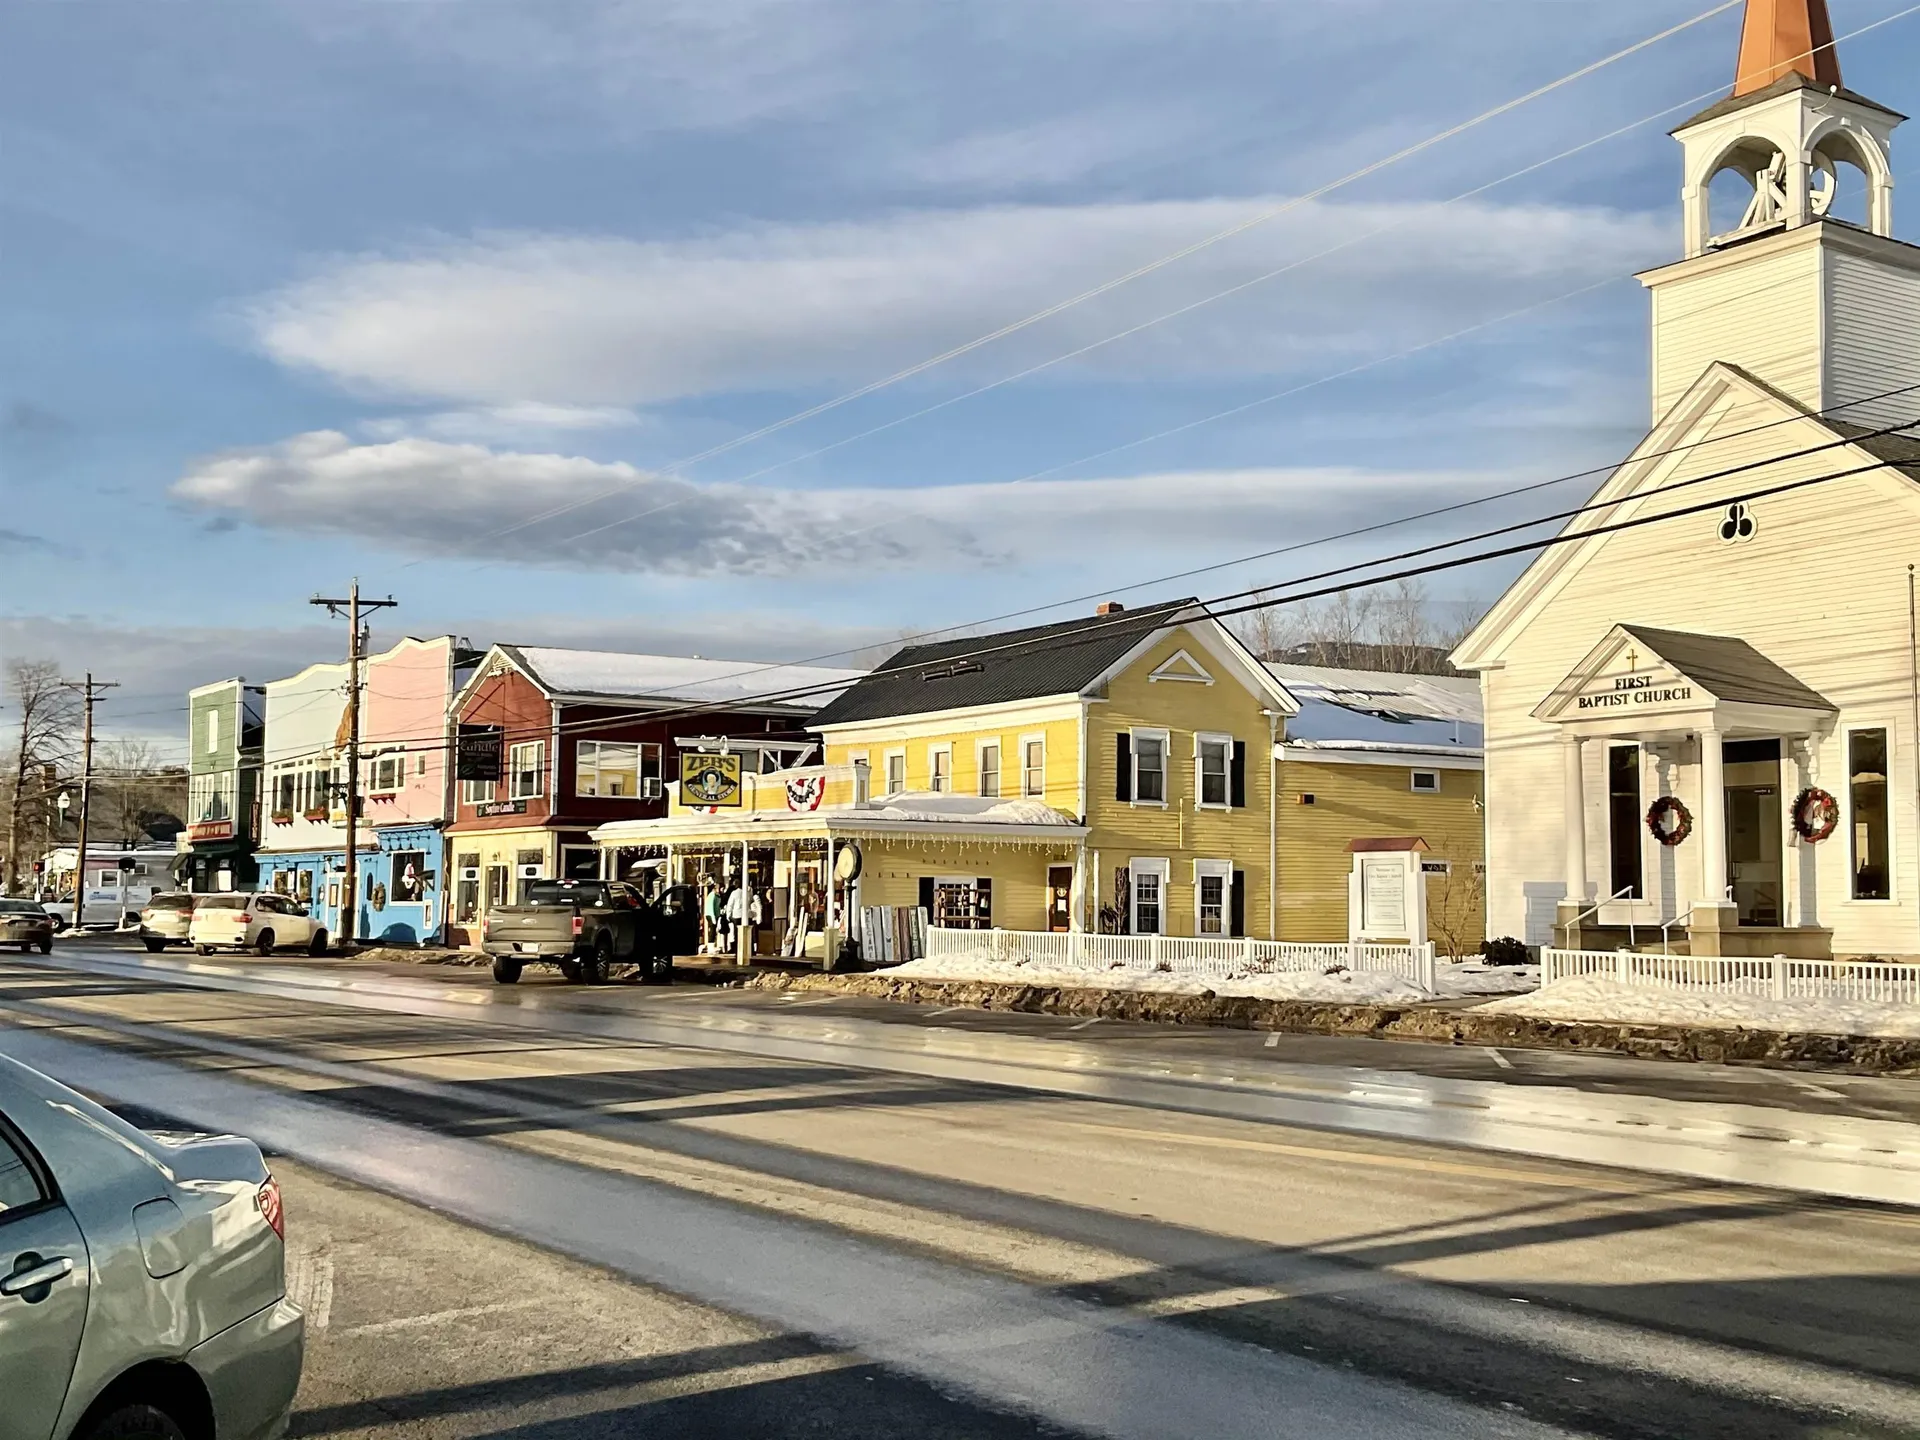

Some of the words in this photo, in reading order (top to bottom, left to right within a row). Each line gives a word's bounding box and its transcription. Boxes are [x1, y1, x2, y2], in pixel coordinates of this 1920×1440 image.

[1615, 676, 1652, 690] FIRST
[1578, 693, 1630, 709] BAPTIST
[1633, 687, 1692, 704] CHURCH
[460, 740, 499, 752] Candle
[686, 756, 736, 772] ZEB'S
